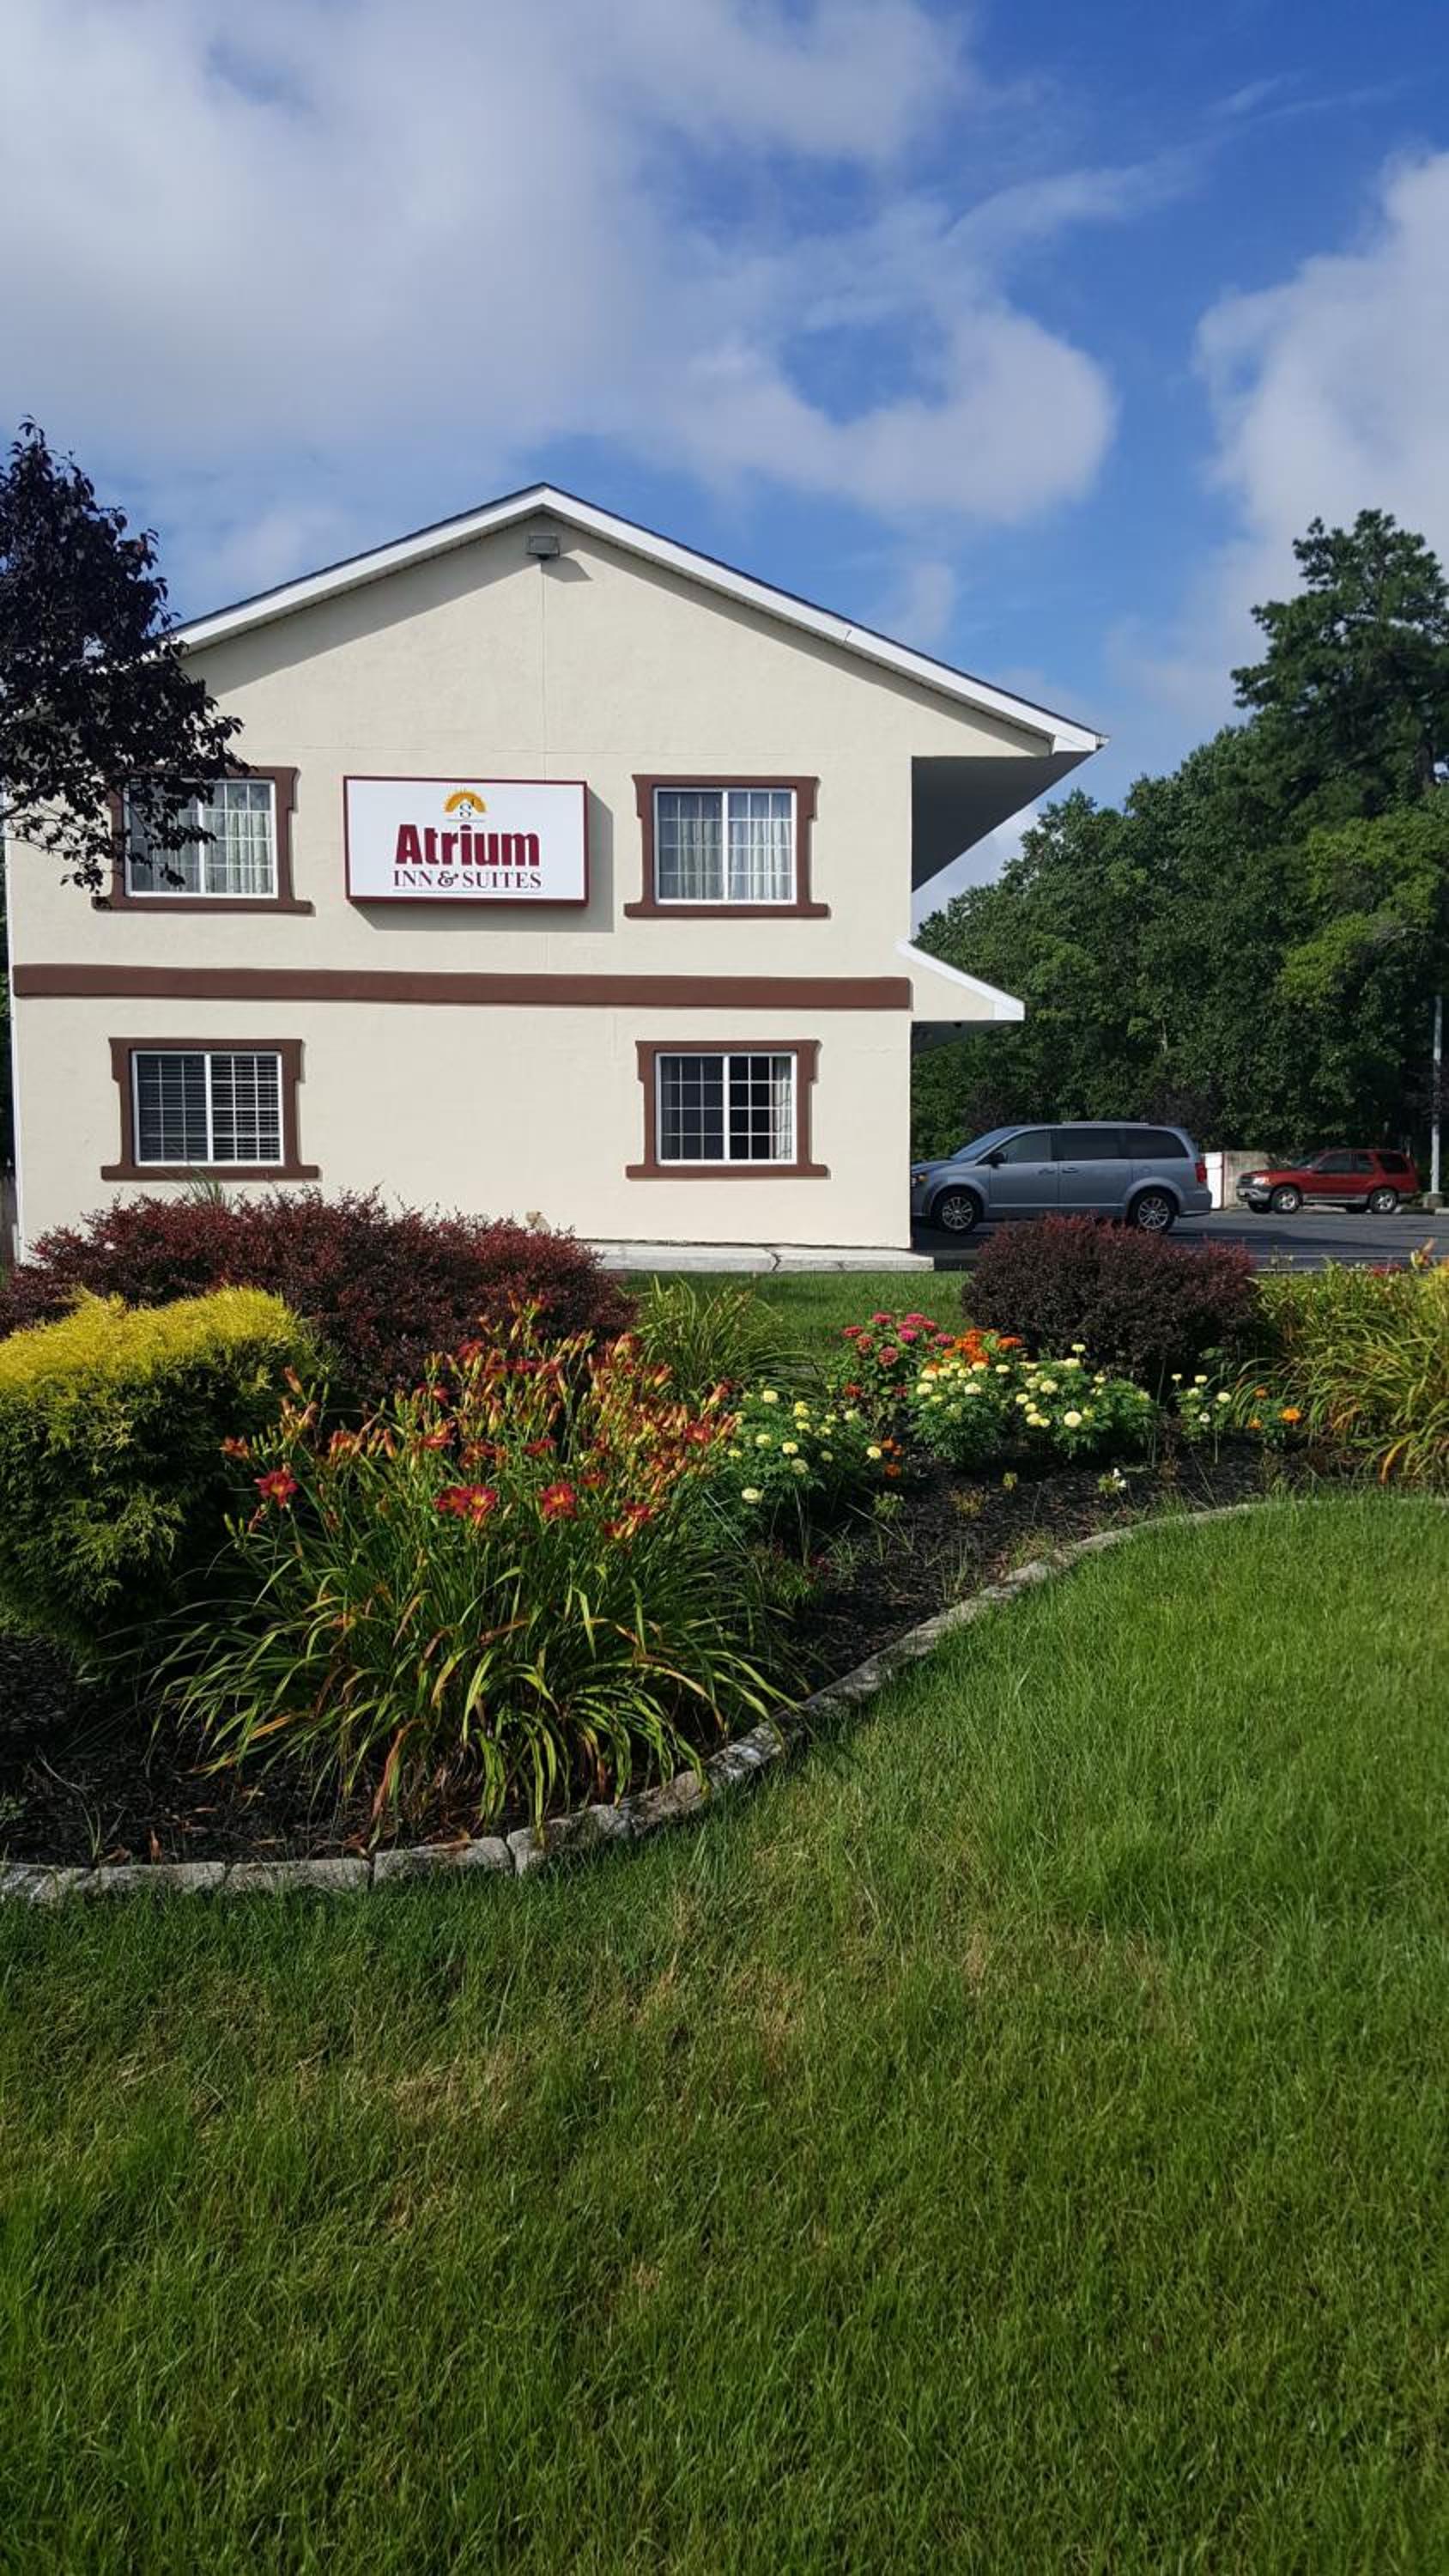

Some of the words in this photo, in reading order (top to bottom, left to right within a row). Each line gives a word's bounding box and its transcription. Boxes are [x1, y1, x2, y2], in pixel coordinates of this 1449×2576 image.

[396, 824, 540, 866] Atrium
[392, 870, 433, 887] INN
[437, 871, 459, 888] &
[462, 871, 542, 889] SUITES
